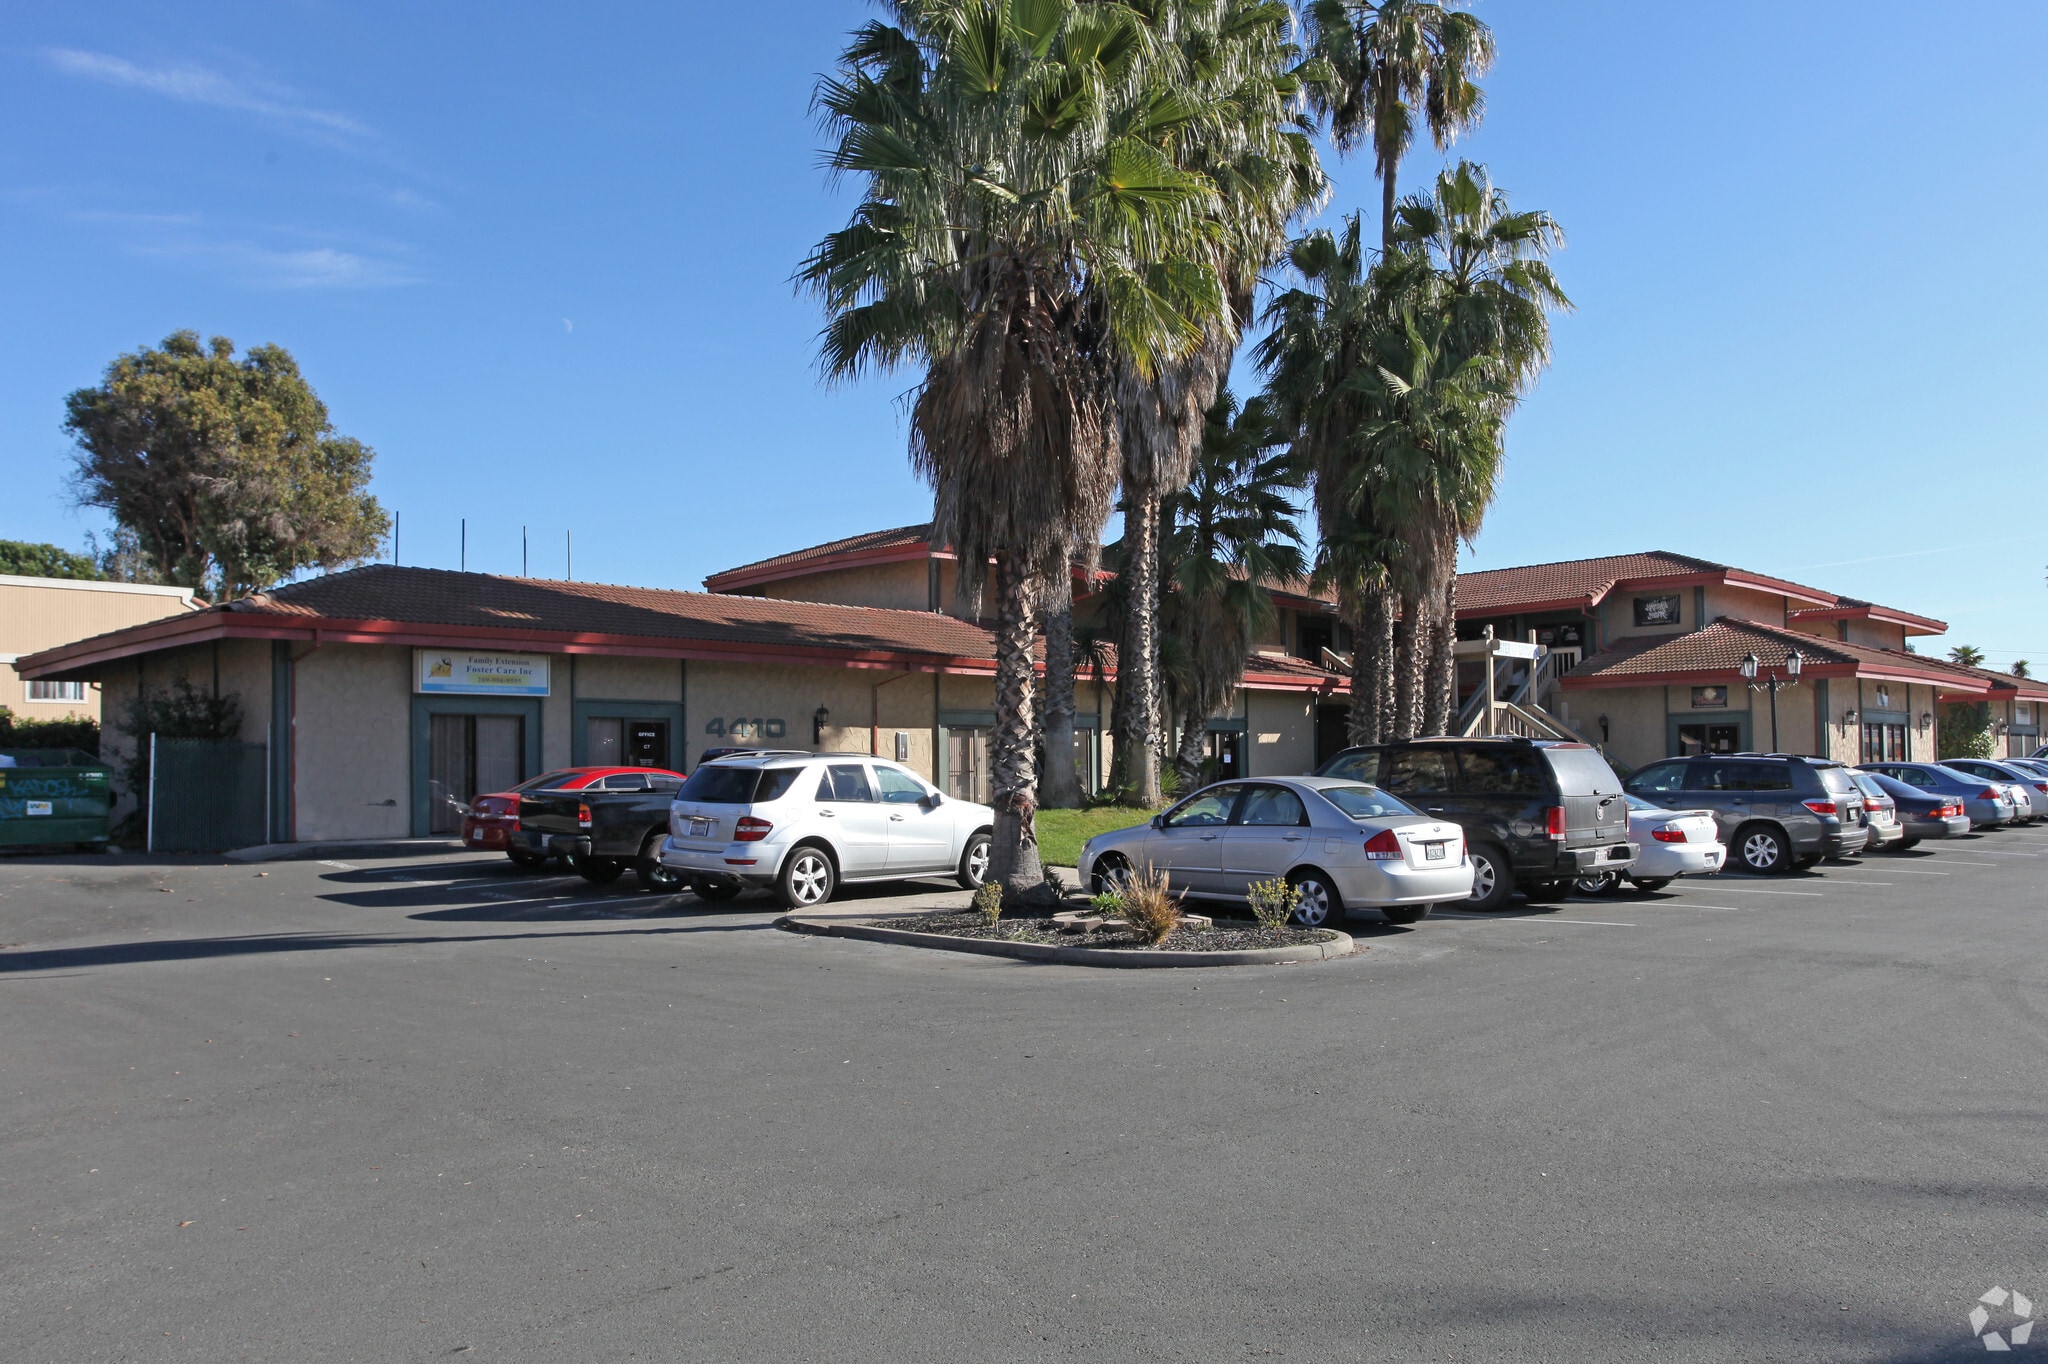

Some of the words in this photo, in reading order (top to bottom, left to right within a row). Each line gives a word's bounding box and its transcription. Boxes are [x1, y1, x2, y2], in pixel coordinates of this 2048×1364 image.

[468, 656, 493, 666] Family
[495, 657, 530, 666] Extension
[466, 665, 493, 674] Foster
[496, 666, 517, 675] Care
[519, 667, 533, 675] Inc
[705, 717, 786, 738] 4410
